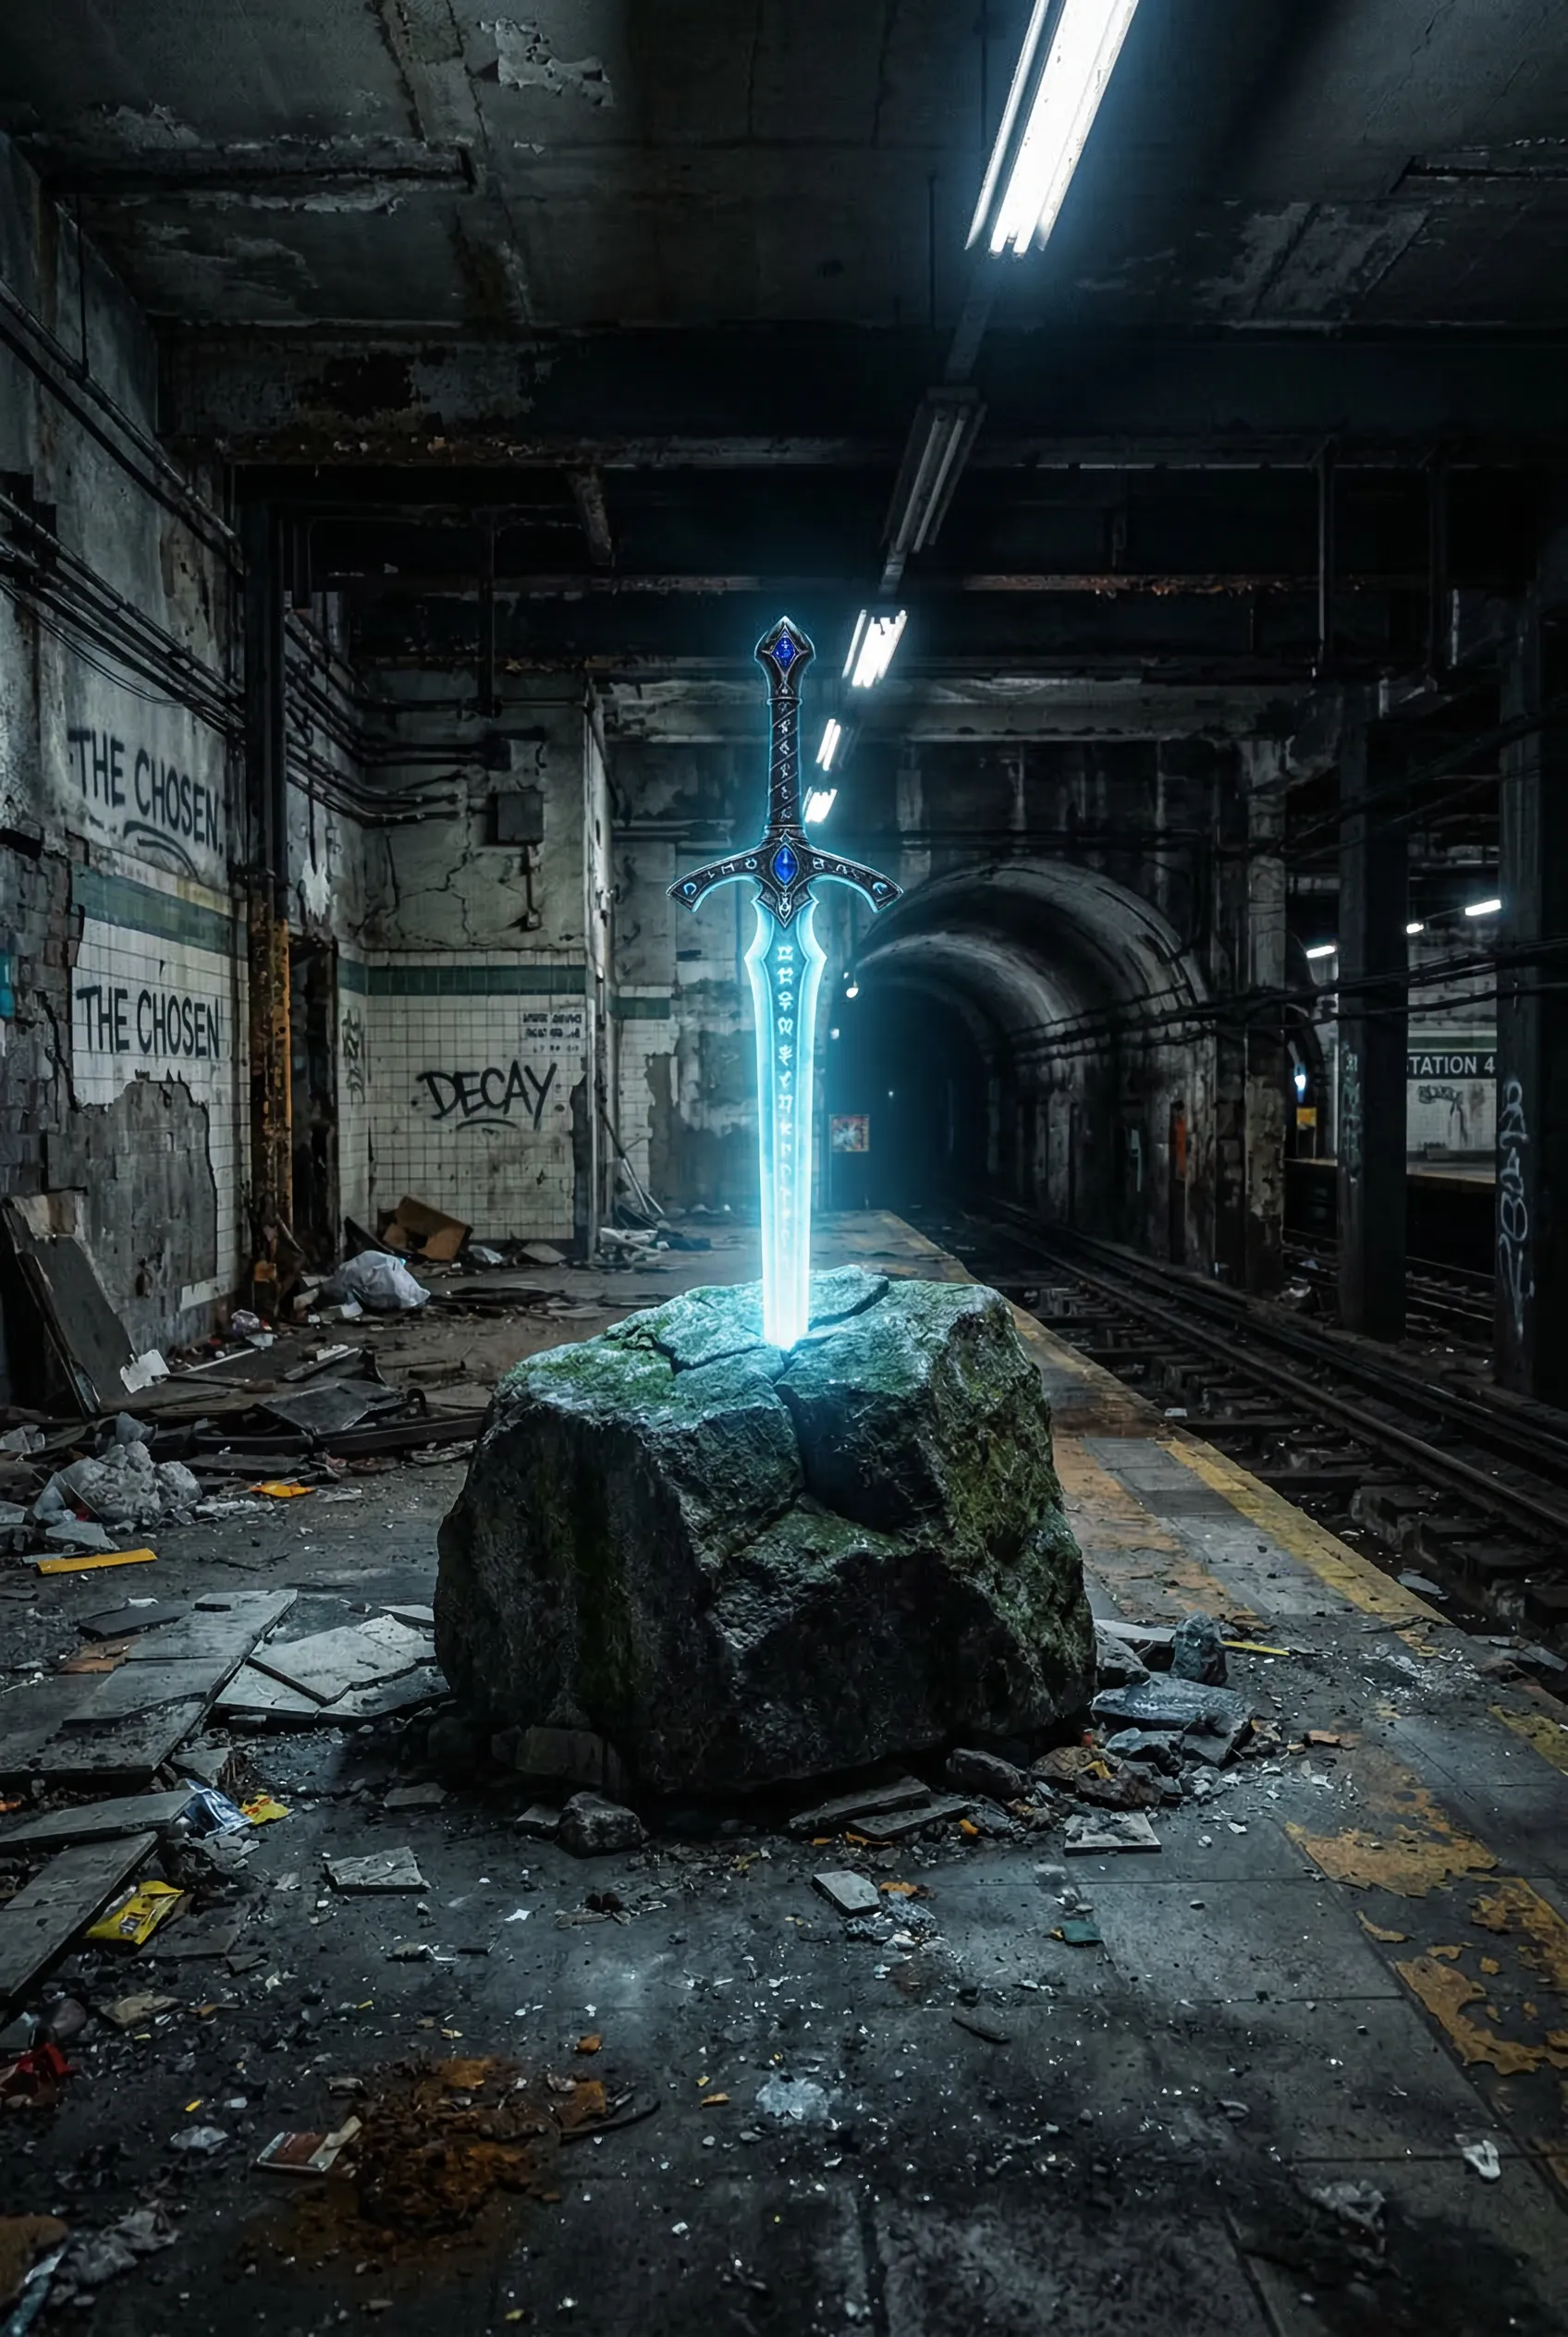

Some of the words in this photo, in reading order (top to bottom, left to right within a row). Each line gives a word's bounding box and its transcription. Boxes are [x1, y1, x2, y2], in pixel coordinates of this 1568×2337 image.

[67, 728, 125, 808] THE
[76, 985, 129, 1054] THE
[137, 989, 219, 1058] CHOSEN
[417, 1059, 557, 1130] DECAY
[1406, 1056, 1476, 1074] TATION
[1484, 1056, 1495, 1074] 4
